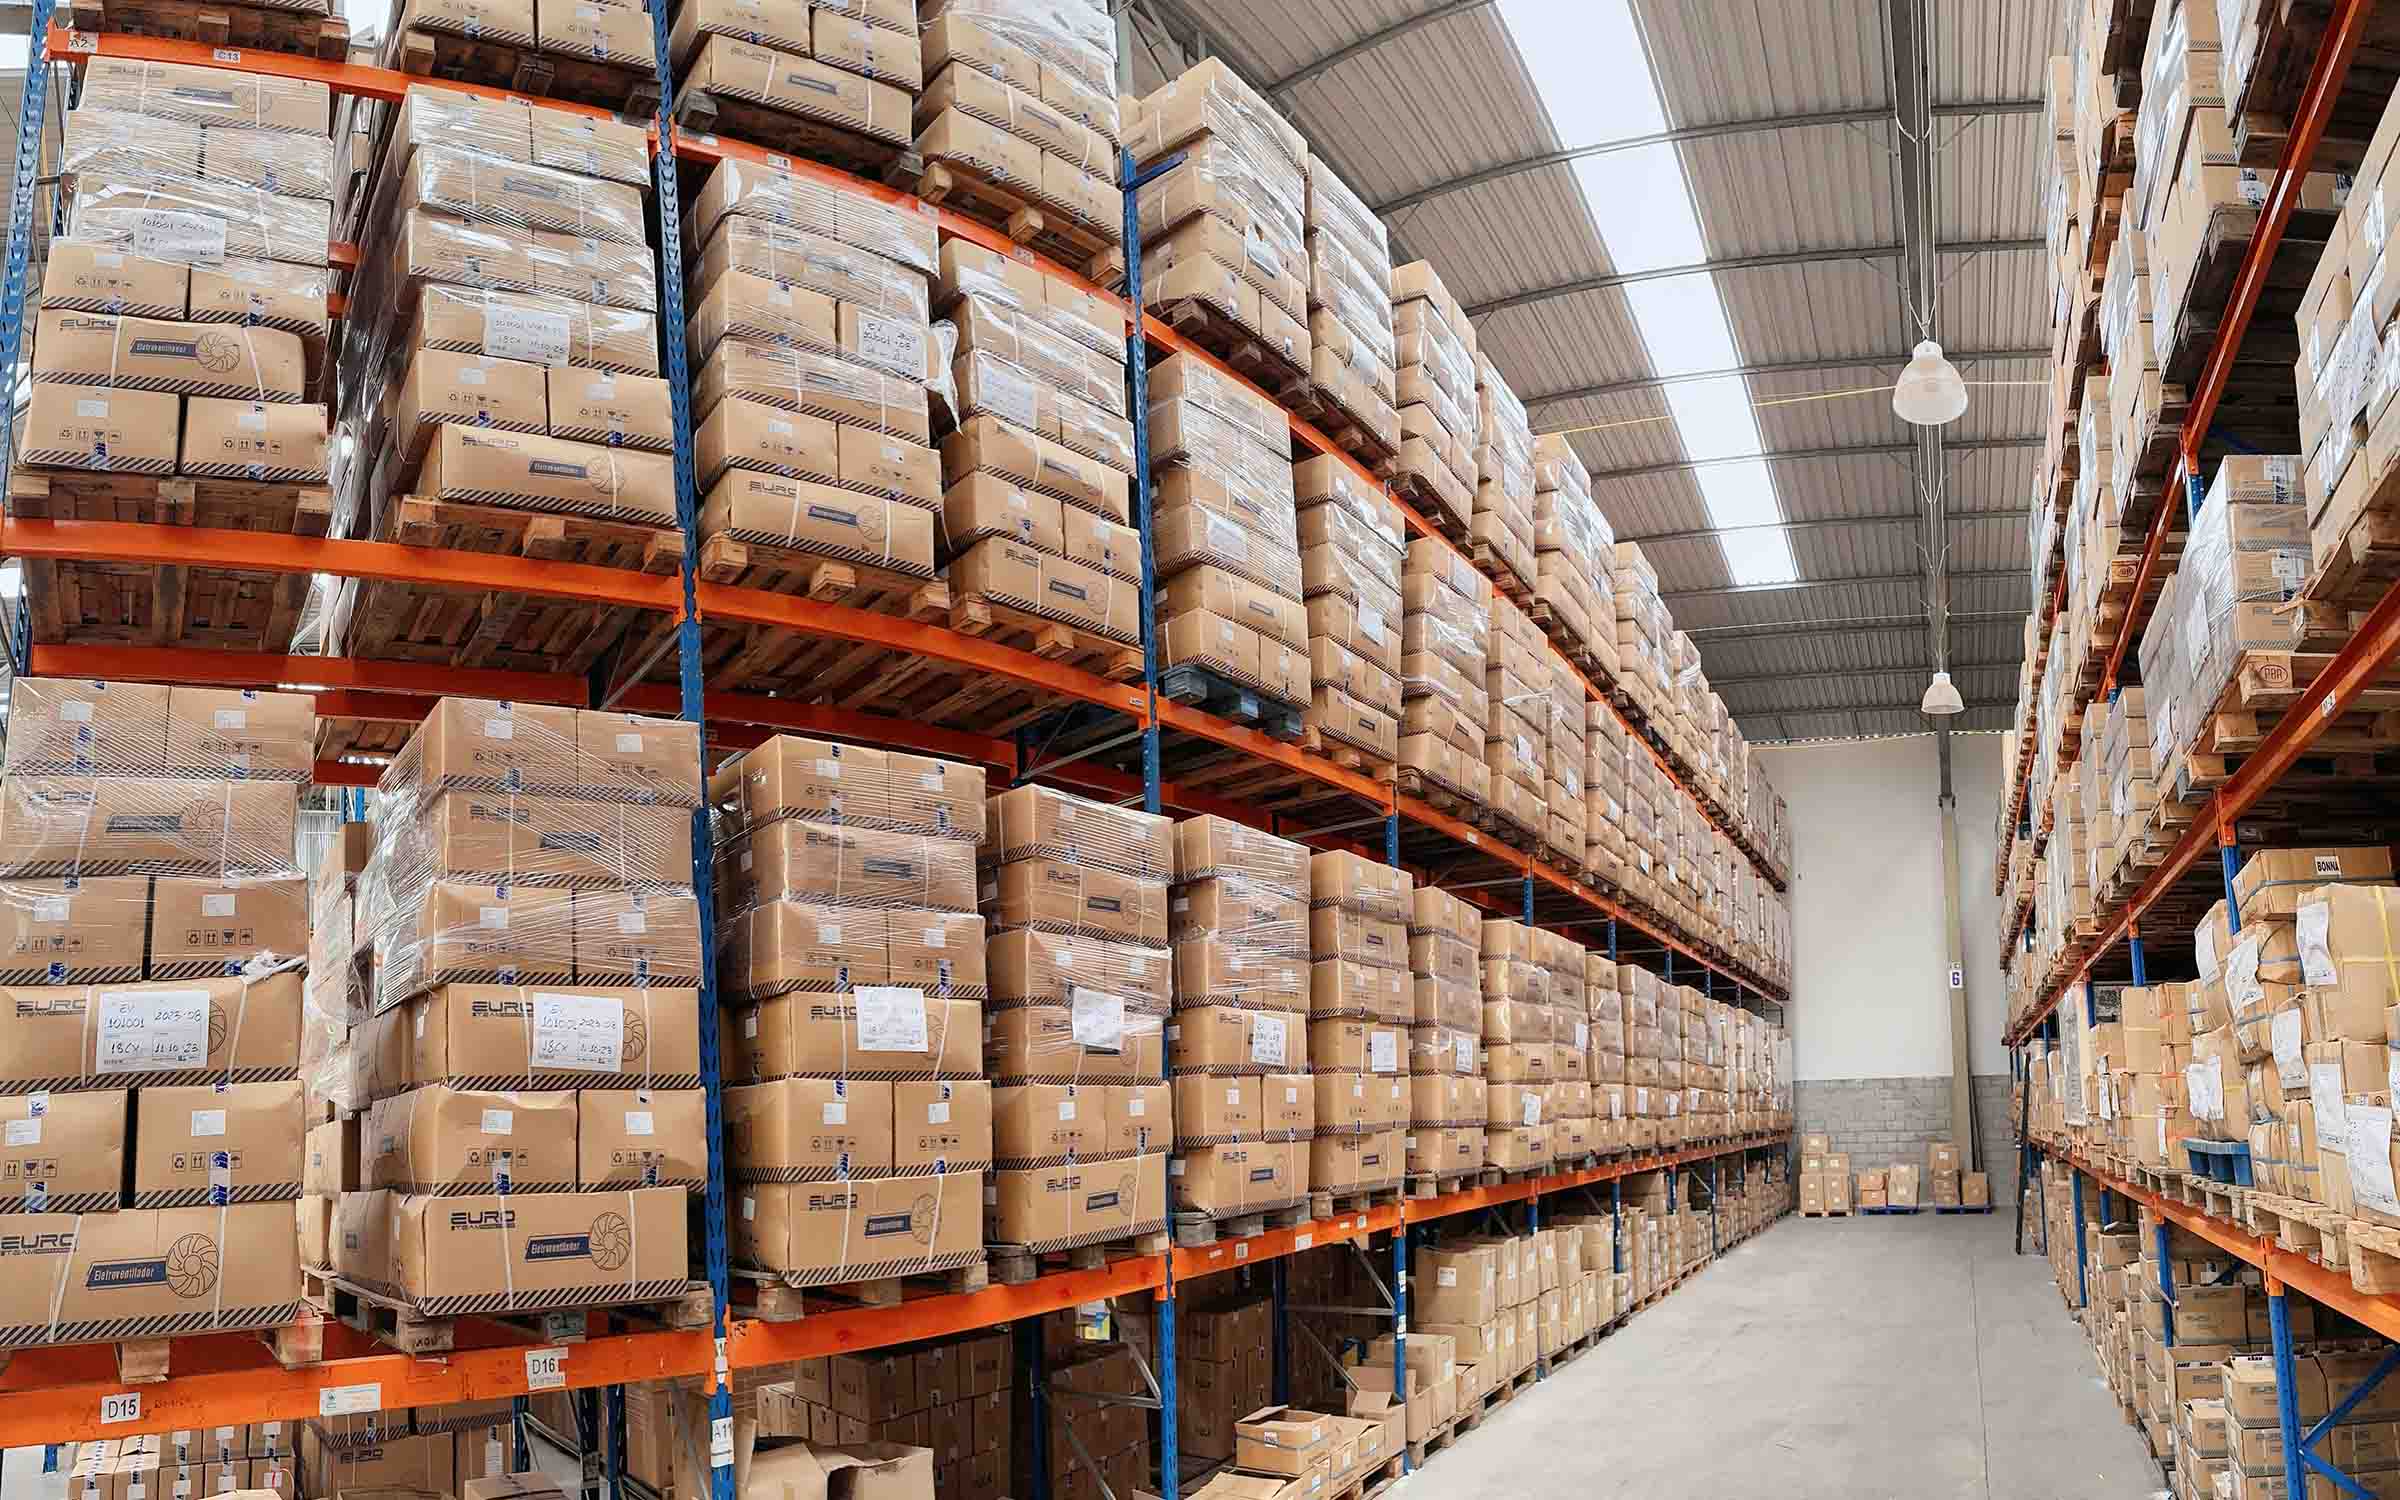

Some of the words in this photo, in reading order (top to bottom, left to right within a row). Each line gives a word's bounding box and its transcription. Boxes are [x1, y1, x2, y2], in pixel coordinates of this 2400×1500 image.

[217, 51, 239, 62] C13
[1952, 971, 1960, 986] 6
[451, 1210, 516, 1225] EURO
[94, 1266, 155, 1281] Eletroventilador
[532, 1357, 556, 1375] D16
[108, 1399, 137, 1418] D15
